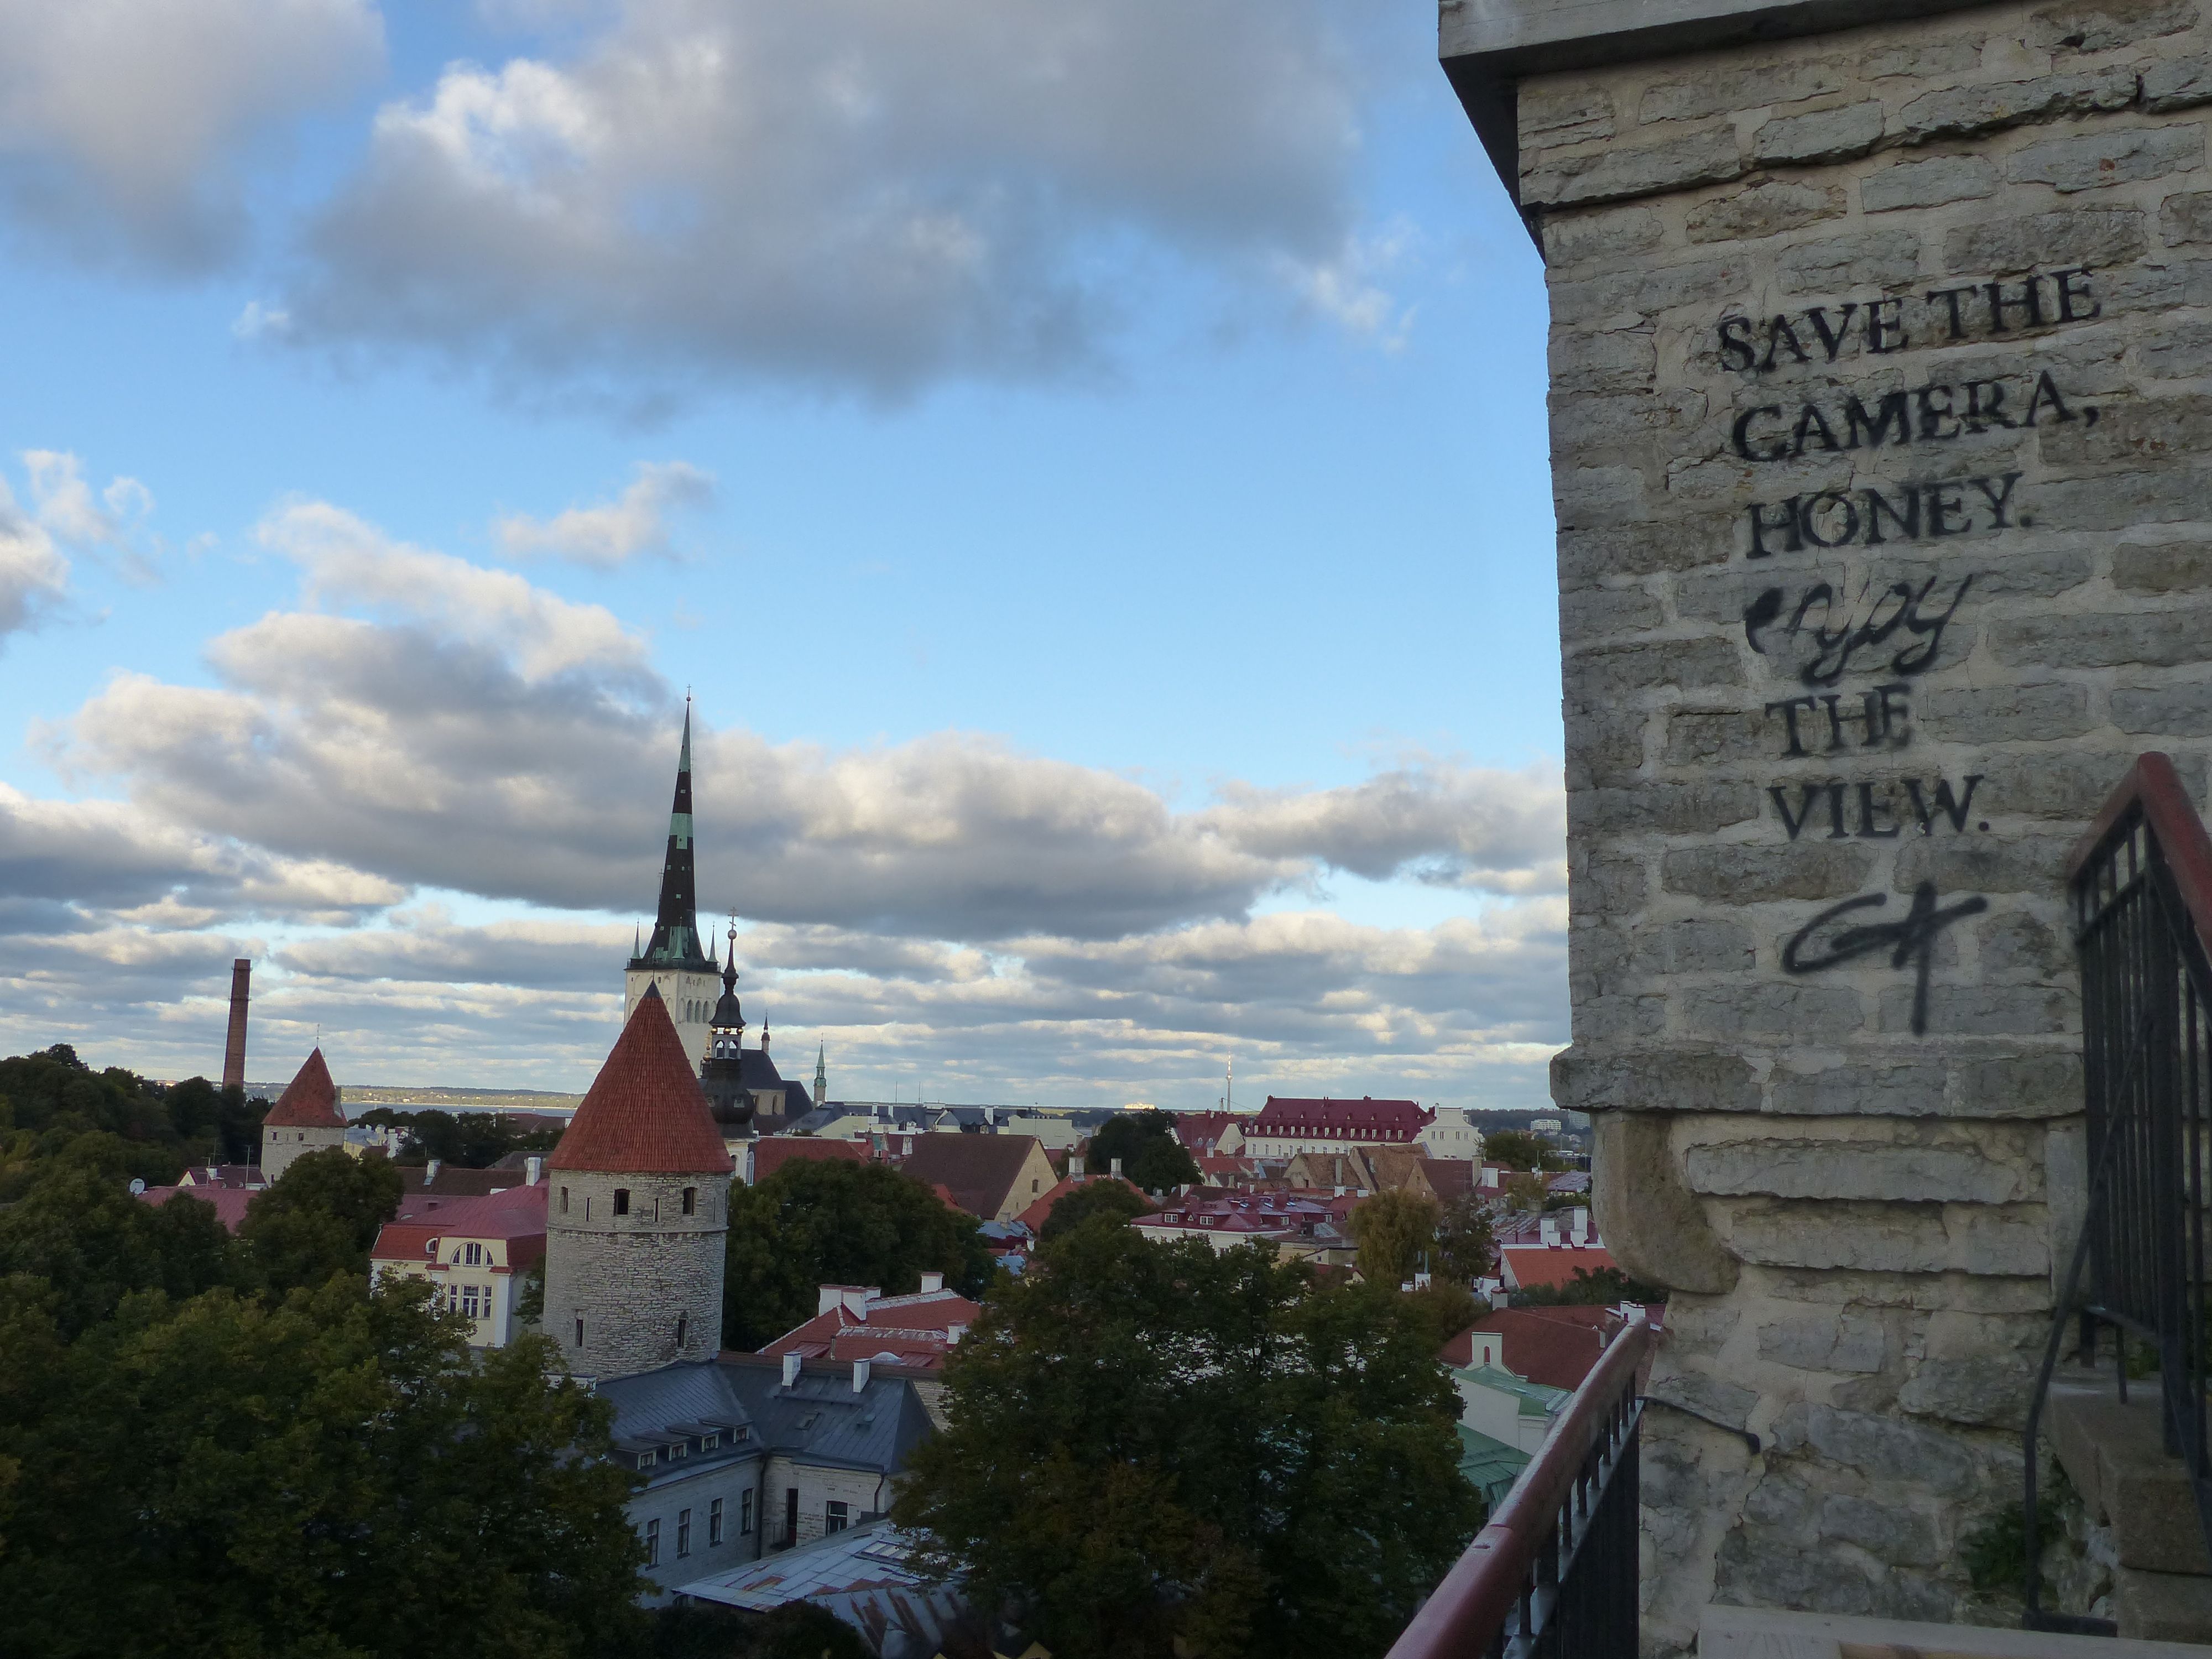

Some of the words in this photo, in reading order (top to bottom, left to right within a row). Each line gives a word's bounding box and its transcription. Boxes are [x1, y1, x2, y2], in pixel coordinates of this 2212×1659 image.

[1716, 296, 1908, 373] SAVE
[1927, 268, 2101, 341] THE
[1732, 369, 2099, 462] CAMERA,
[1745, 473, 2033, 558] HONEY.
[1743, 572, 1973, 686] enjoy
[1765, 684, 1913, 758] THE
[1767, 775, 1990, 841] VIEW.
